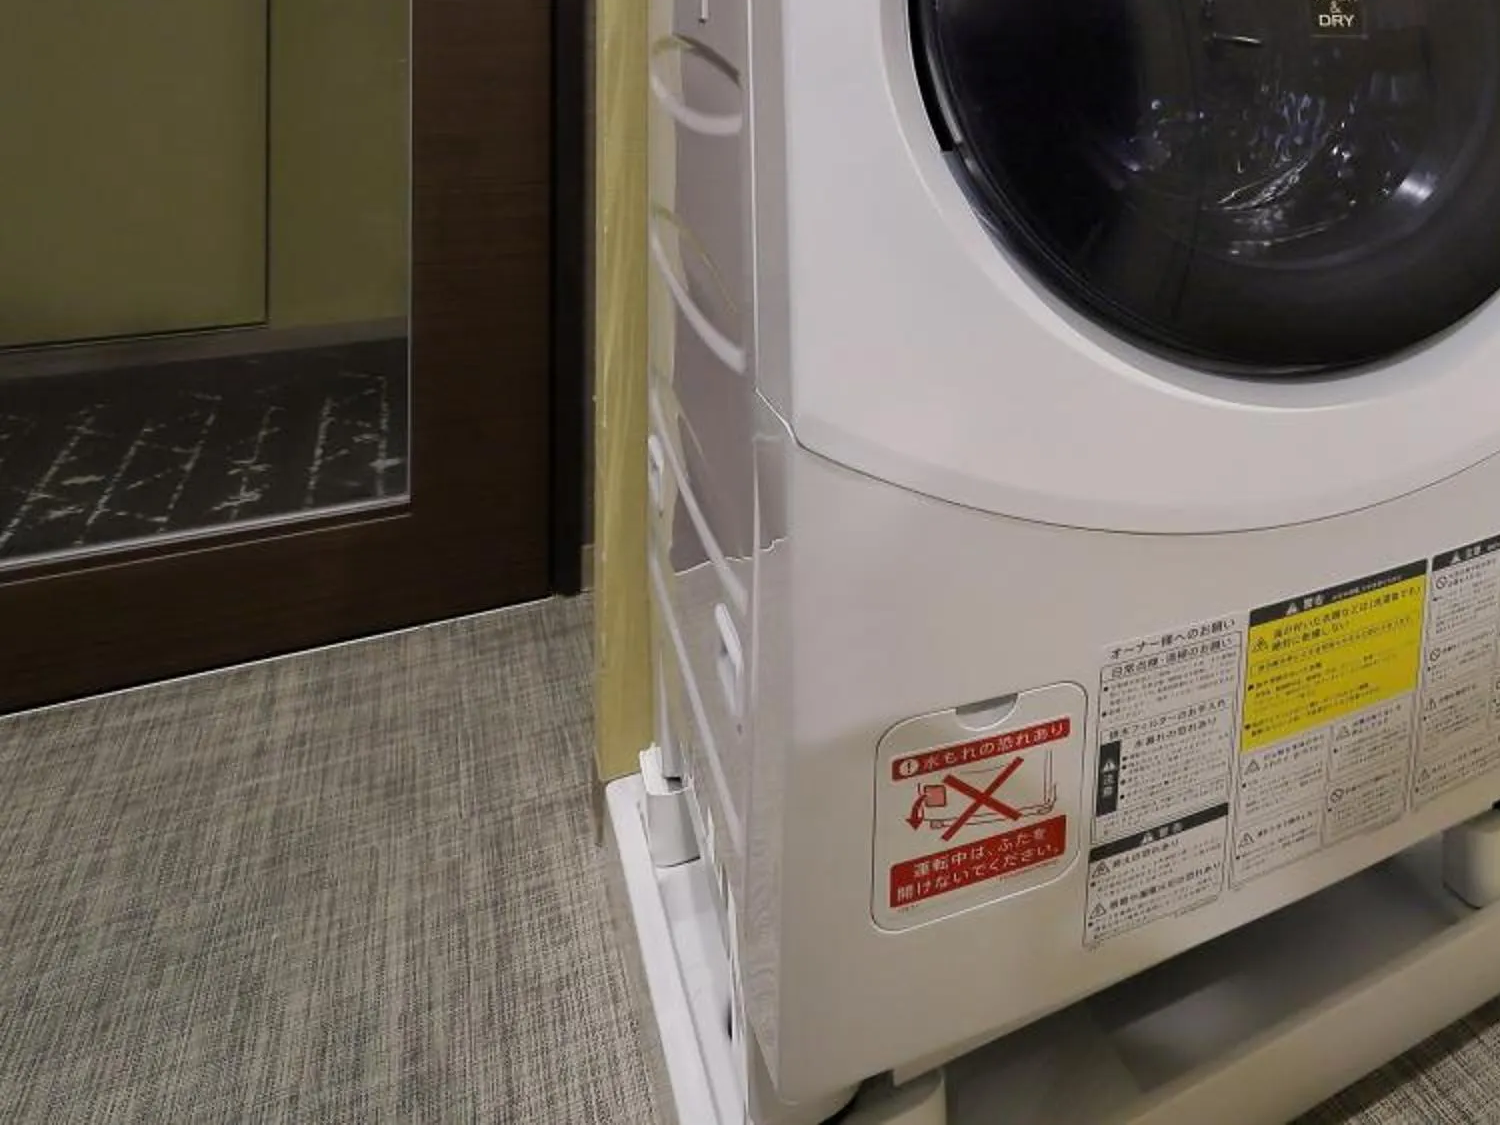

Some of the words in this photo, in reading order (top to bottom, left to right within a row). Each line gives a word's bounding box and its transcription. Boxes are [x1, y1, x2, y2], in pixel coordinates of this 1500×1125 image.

[1330, 0, 1342, 14] &
[1318, 14, 1355, 27] DRY
[1110, 619, 1235, 659] オーナー様へのお願い
